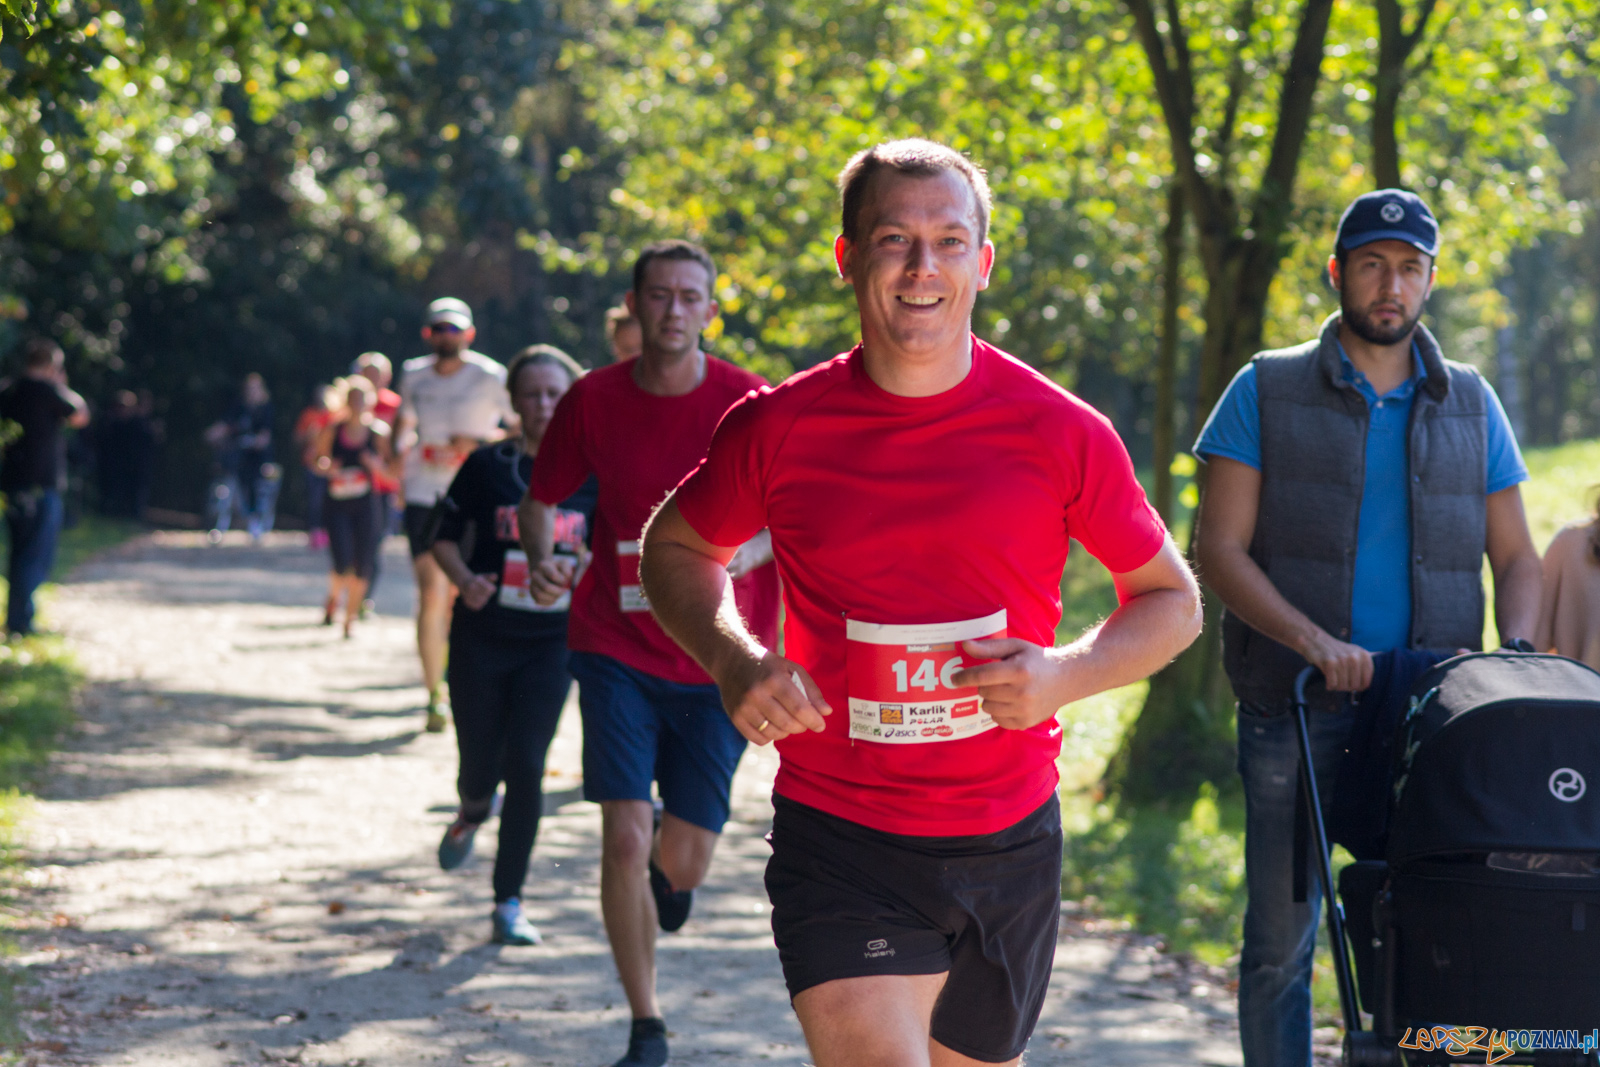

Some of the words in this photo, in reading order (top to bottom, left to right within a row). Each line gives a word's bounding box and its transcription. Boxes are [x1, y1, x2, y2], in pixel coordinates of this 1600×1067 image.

[892, 656, 964, 692] 146
[909, 705, 946, 716] Karlik
[909, 717, 944, 725] POLAR
